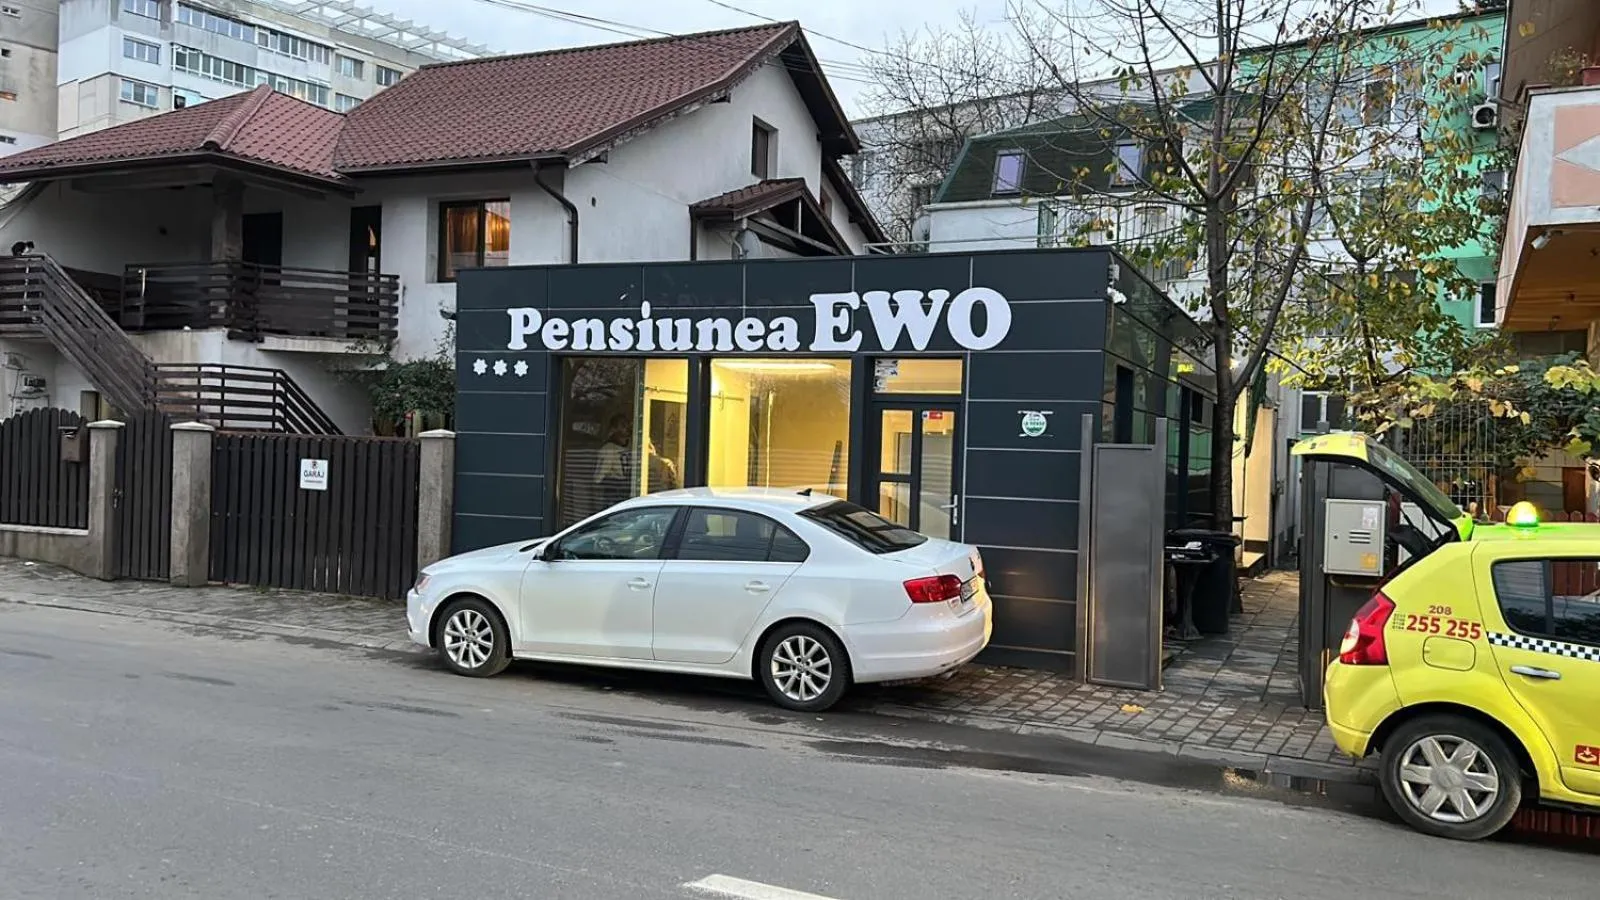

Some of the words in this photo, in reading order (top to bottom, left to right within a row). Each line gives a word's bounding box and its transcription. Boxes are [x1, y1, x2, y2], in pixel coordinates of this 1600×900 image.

[507, 301, 800, 351] Pensiunea
[809, 287, 1012, 352] EWO
[303, 470, 325, 479] GARAJ
[1429, 605, 1452, 615] 208
[1406, 615, 1440, 634] 255
[1446, 620, 1481, 639] 255
